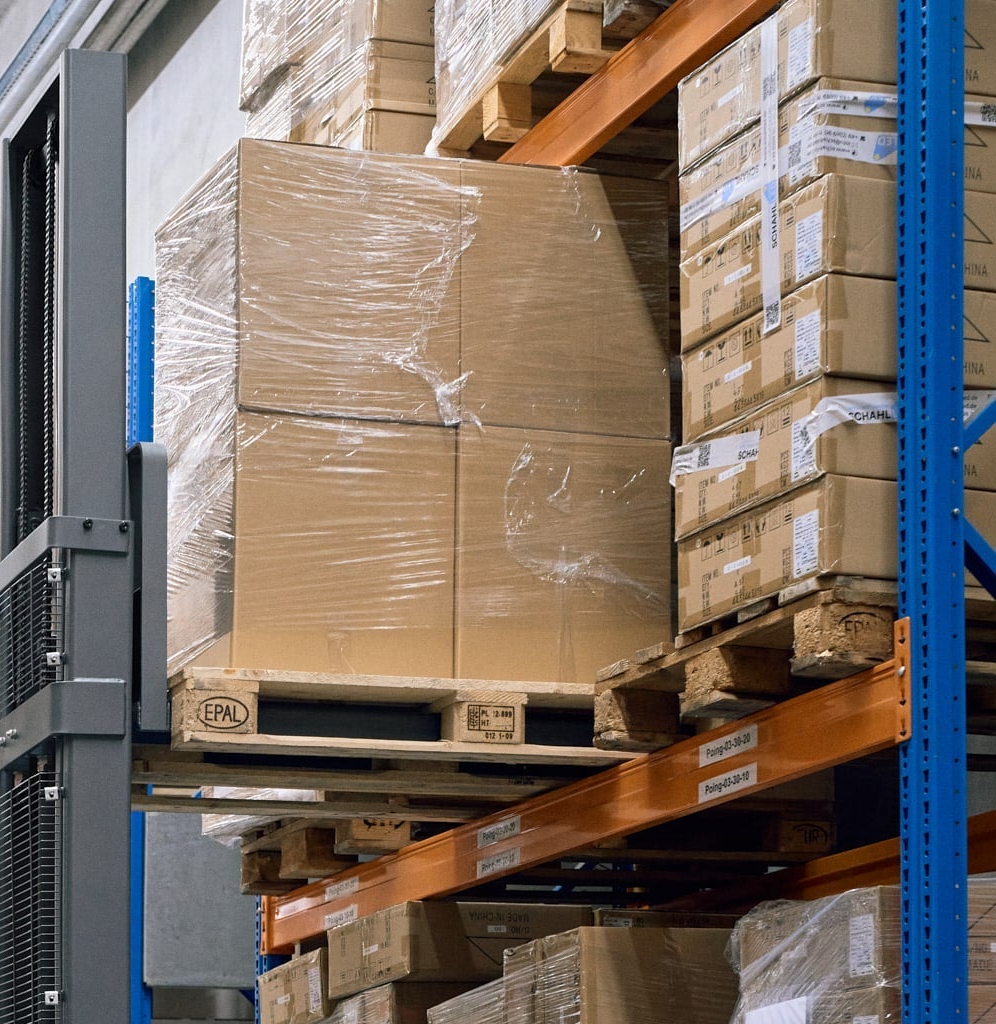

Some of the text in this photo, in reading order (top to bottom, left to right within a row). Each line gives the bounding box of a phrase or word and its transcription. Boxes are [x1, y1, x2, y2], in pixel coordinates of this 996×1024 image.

[964, 263, 988, 277] HINA
[205, 704, 242, 723] EPAL
[481, 709, 489, 718] PL
[706, 732, 751, 760] Poing-03-30-20
[705, 770, 750, 796] Poing-03-30-10
[469, 911, 494, 922] CHINA
[507, 911, 530, 924] MADE
